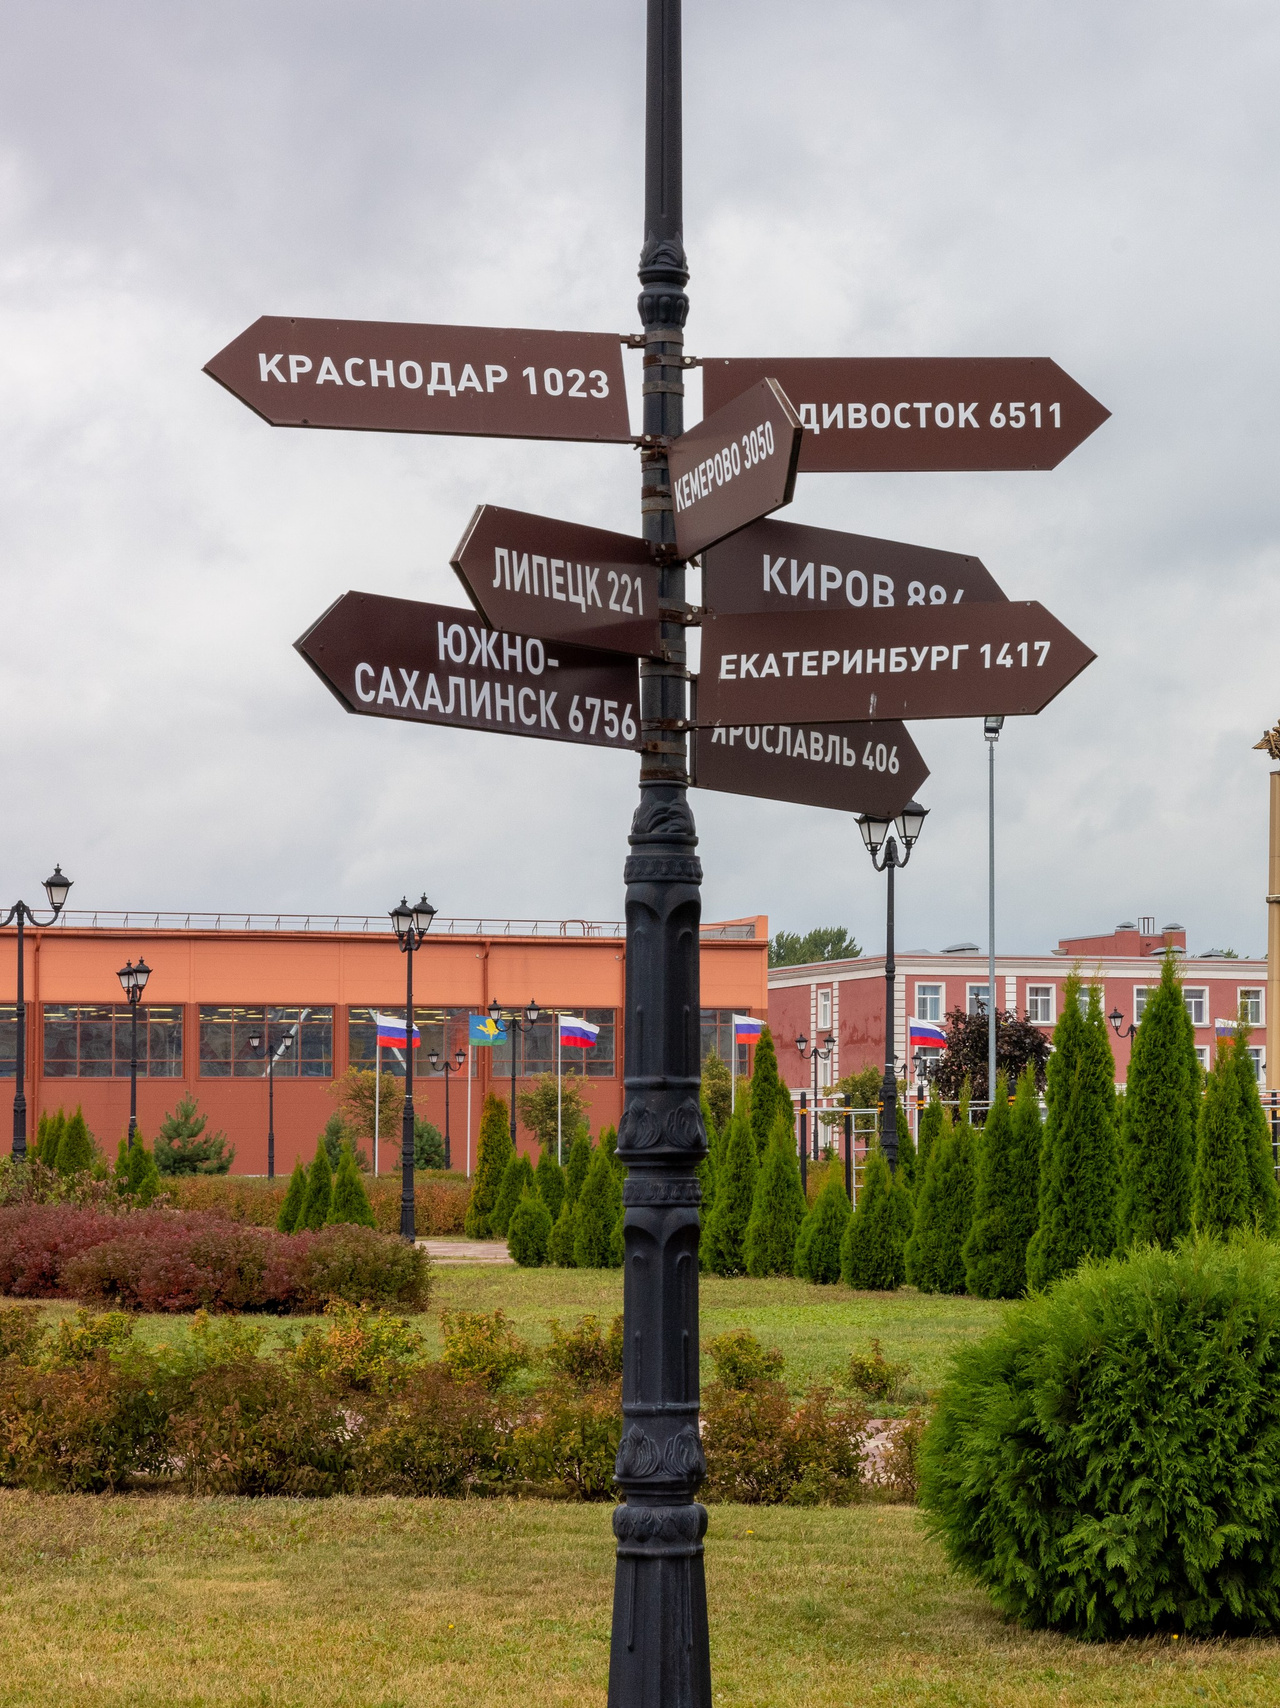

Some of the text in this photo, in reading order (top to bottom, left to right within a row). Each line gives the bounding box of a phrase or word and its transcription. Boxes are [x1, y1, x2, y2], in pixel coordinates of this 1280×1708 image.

[258, 352, 610, 399] КРАСНОДАР 1023
[800, 402, 1062, 435] ДИВОСТОК 6511
[673, 420, 775, 513] КЕМЕРОВО 3050
[492, 546, 645, 616] ЛИПЕЦК 221
[763, 554, 895, 608] КИРОВ
[437, 621, 560, 676] ЮЖНО-
[718, 640, 1052, 680] ЕКАТЕРИНБУРГ 1417
[354, 662, 638, 741] САХАЛИНСК 6756
[710, 725, 901, 775] ЯРОСЛАВЛЬ 406
